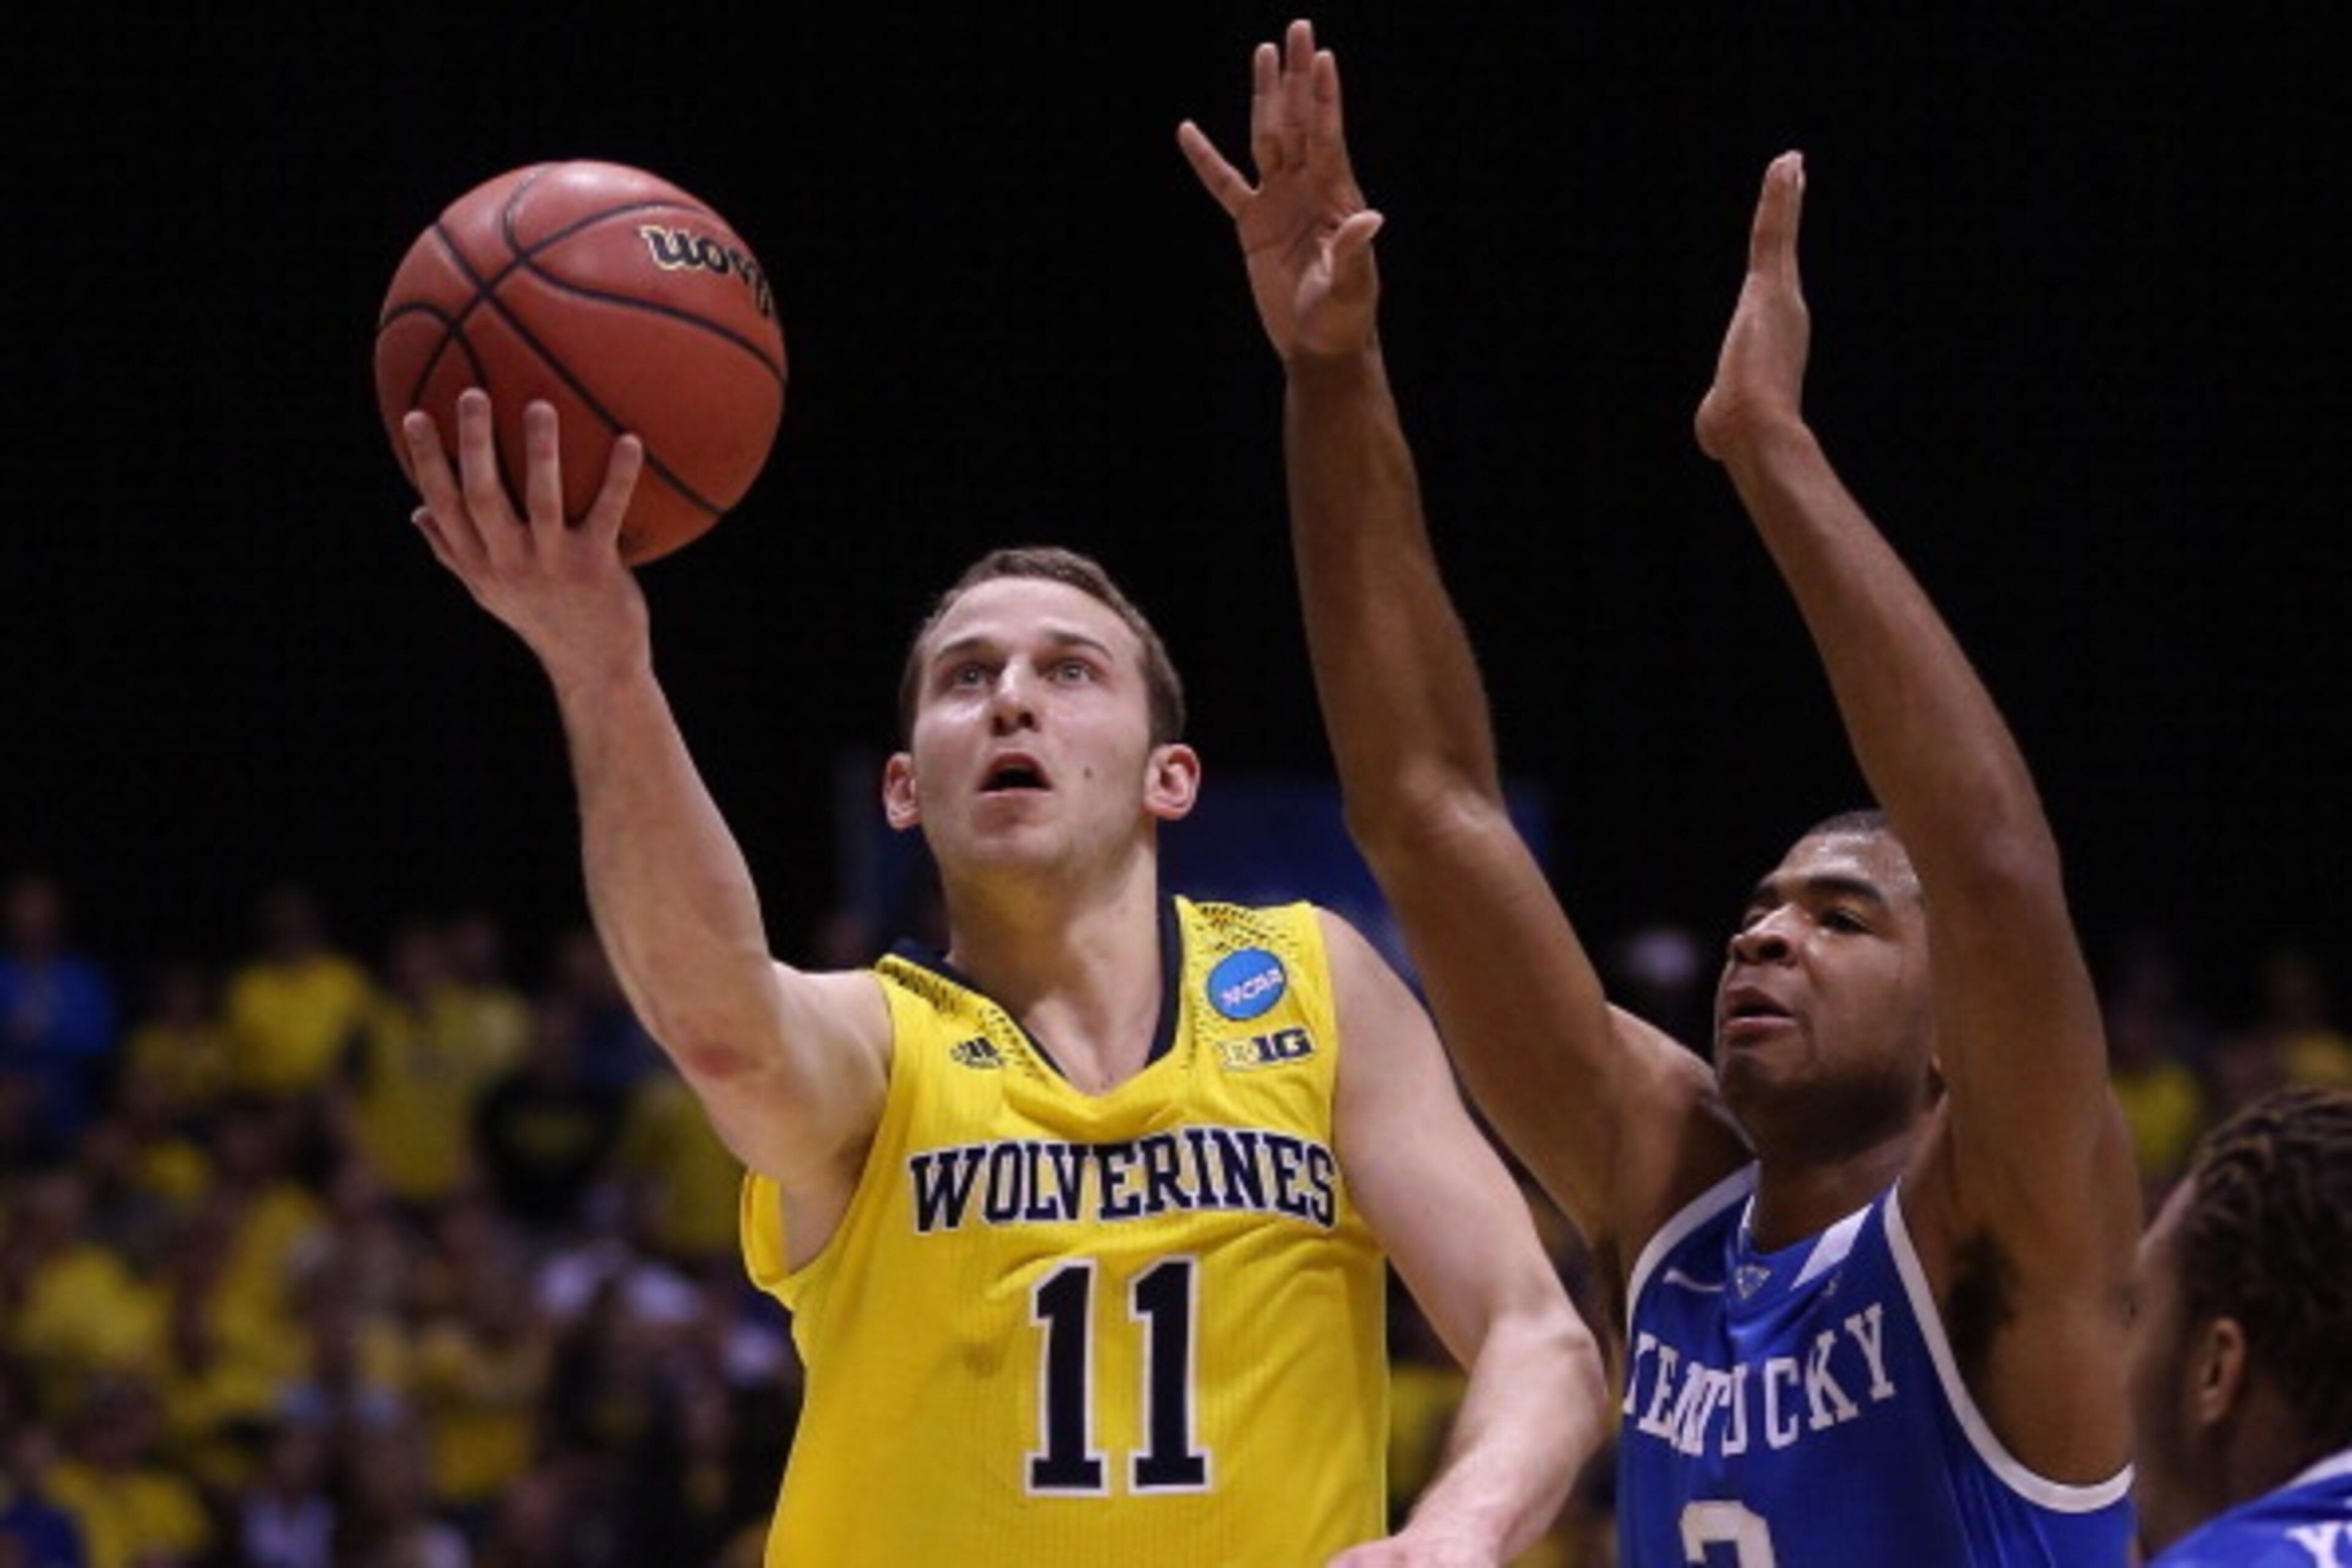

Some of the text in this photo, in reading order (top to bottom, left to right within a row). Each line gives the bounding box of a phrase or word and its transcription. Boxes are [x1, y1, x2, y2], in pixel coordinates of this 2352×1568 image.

[1219, 967, 1284, 1006] NCAA
[908, 1125, 1338, 1232] WOLVERINES
[1025, 1252, 1213, 1495] 11
